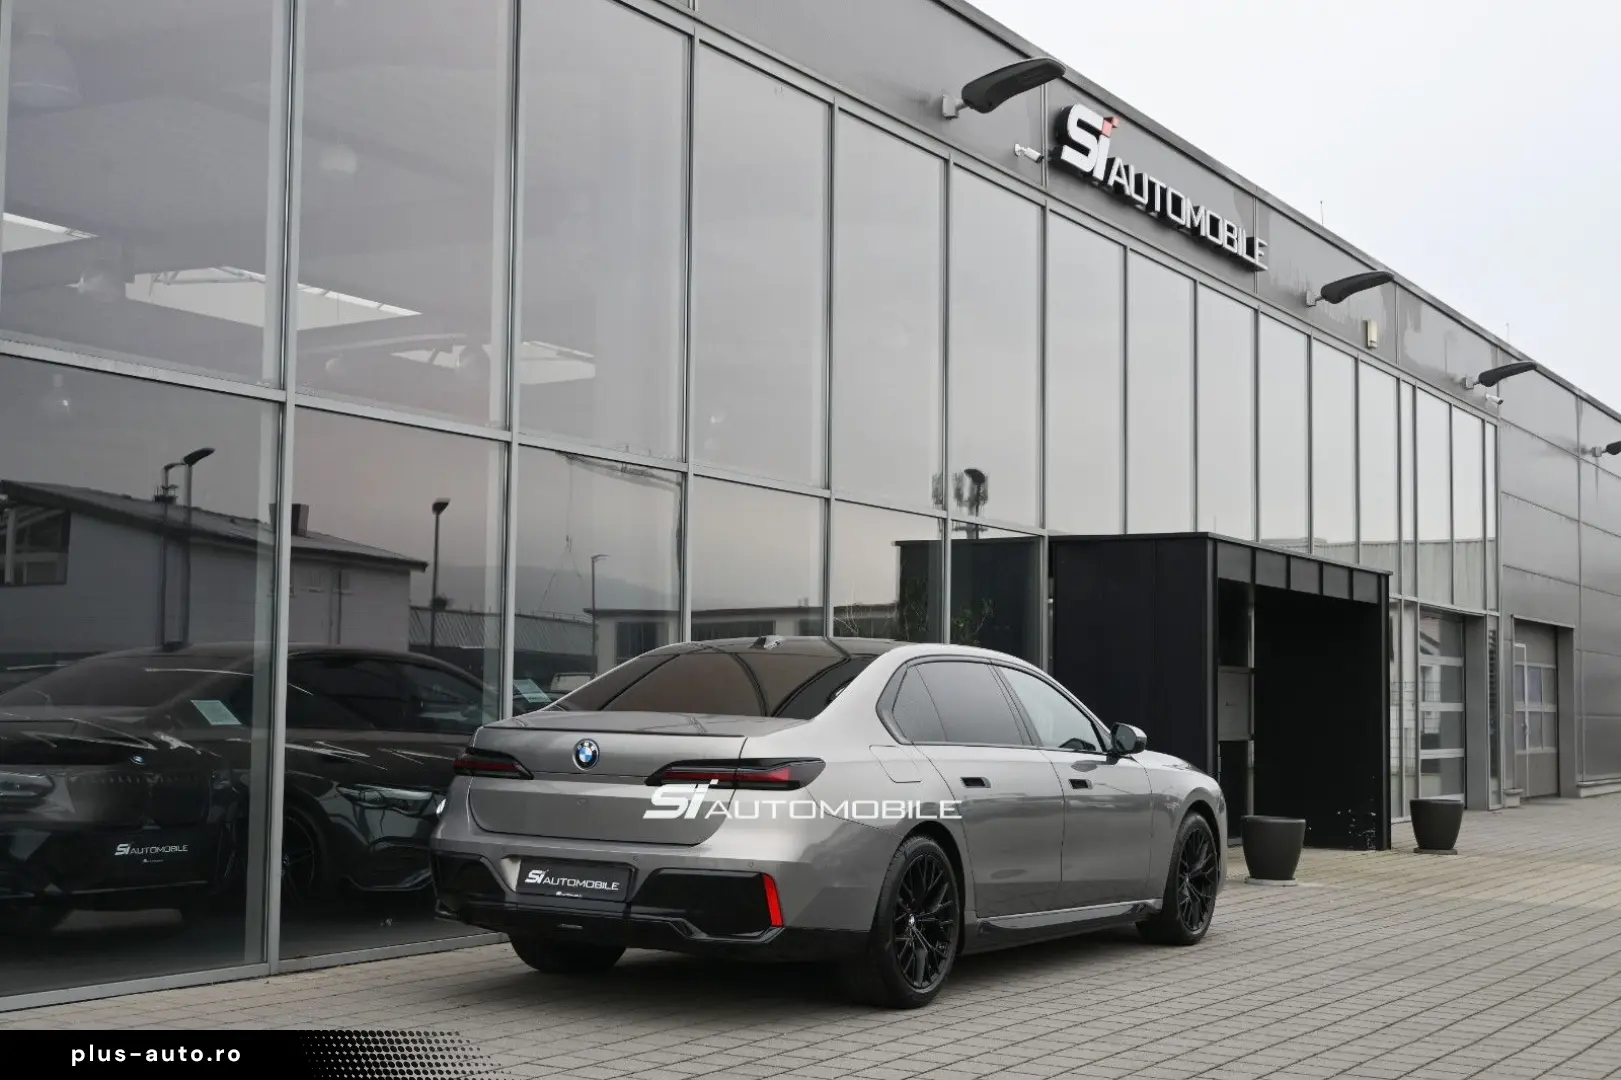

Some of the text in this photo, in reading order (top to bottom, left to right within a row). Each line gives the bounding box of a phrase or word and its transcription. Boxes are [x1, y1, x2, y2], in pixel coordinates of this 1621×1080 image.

[1106, 156, 1269, 271] AUTOMOBILE
[130, 844, 189, 855] AUTOMOBILE
[542, 877, 620, 891] AUTOMOBILE
